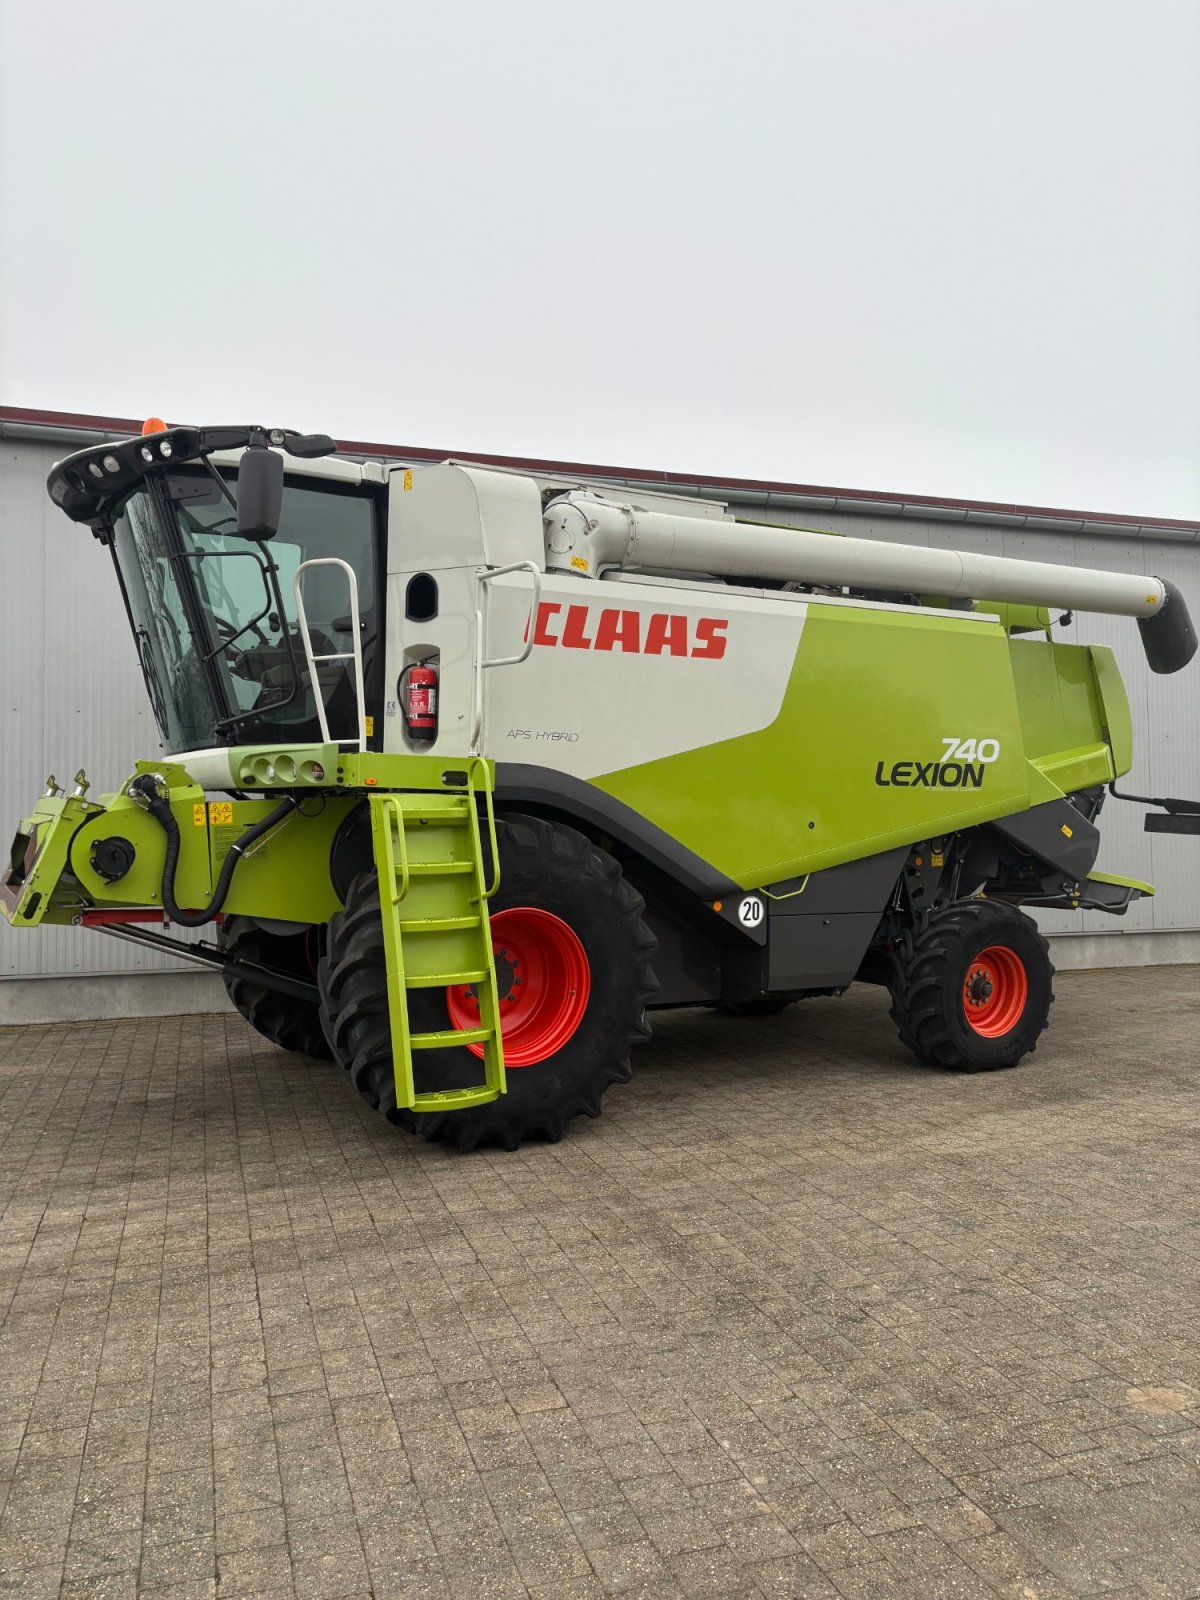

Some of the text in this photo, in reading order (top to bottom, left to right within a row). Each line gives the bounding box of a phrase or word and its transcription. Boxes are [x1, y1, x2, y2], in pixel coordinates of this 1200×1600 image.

[524, 602, 729, 660] CLAAS
[506, 729, 580, 742] APS HYBRID
[940, 738, 1000, 763] 740
[875, 761, 985, 787] LEXION
[743, 901, 760, 921] 20
